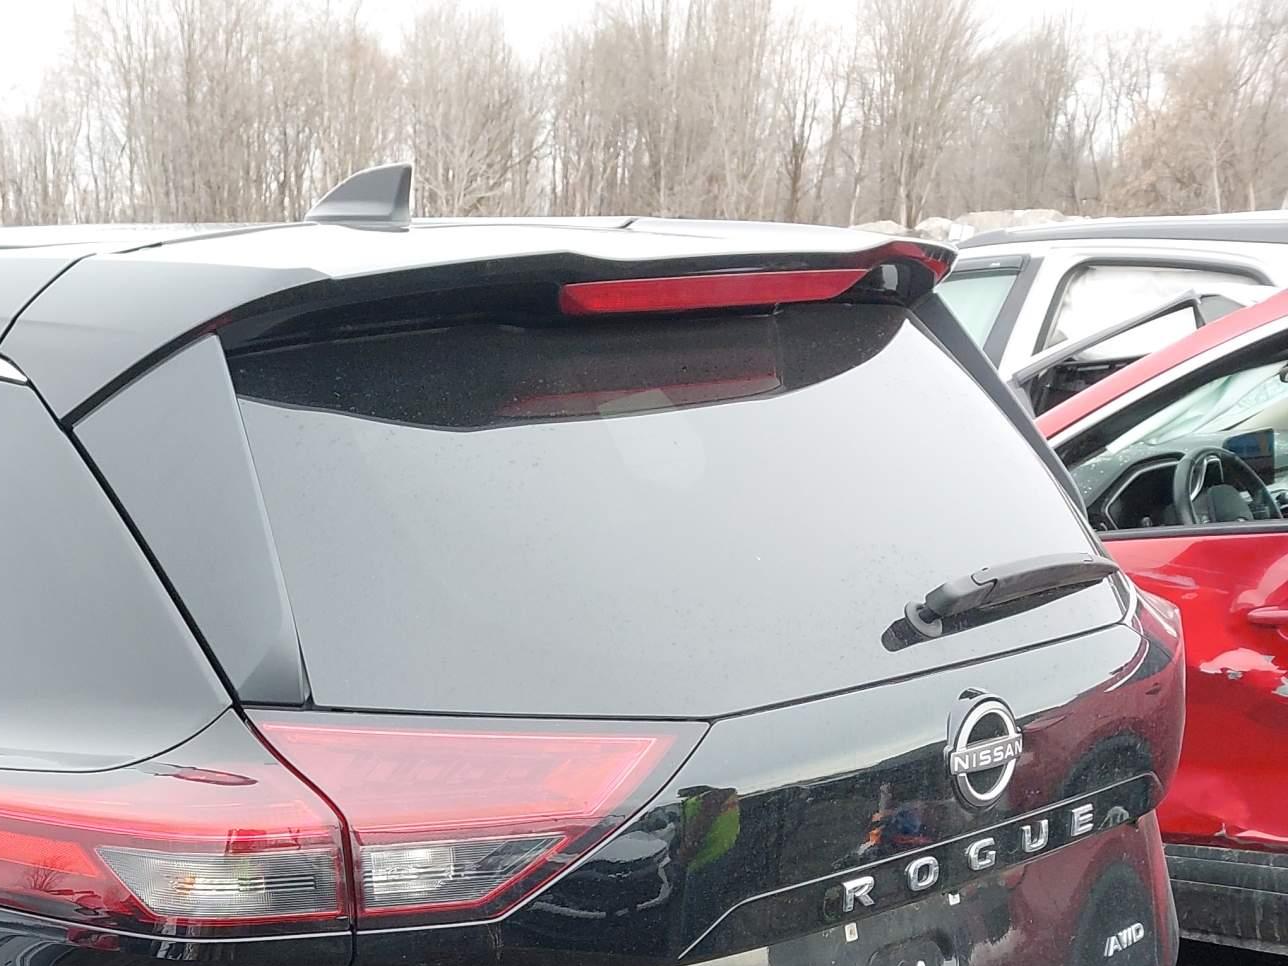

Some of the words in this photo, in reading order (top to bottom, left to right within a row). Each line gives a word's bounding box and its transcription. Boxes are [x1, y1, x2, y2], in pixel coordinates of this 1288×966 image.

[953, 739, 1023, 773] NISSAN
[842, 803, 1095, 912] ROGUE
[1103, 922, 1145, 957] AWD
